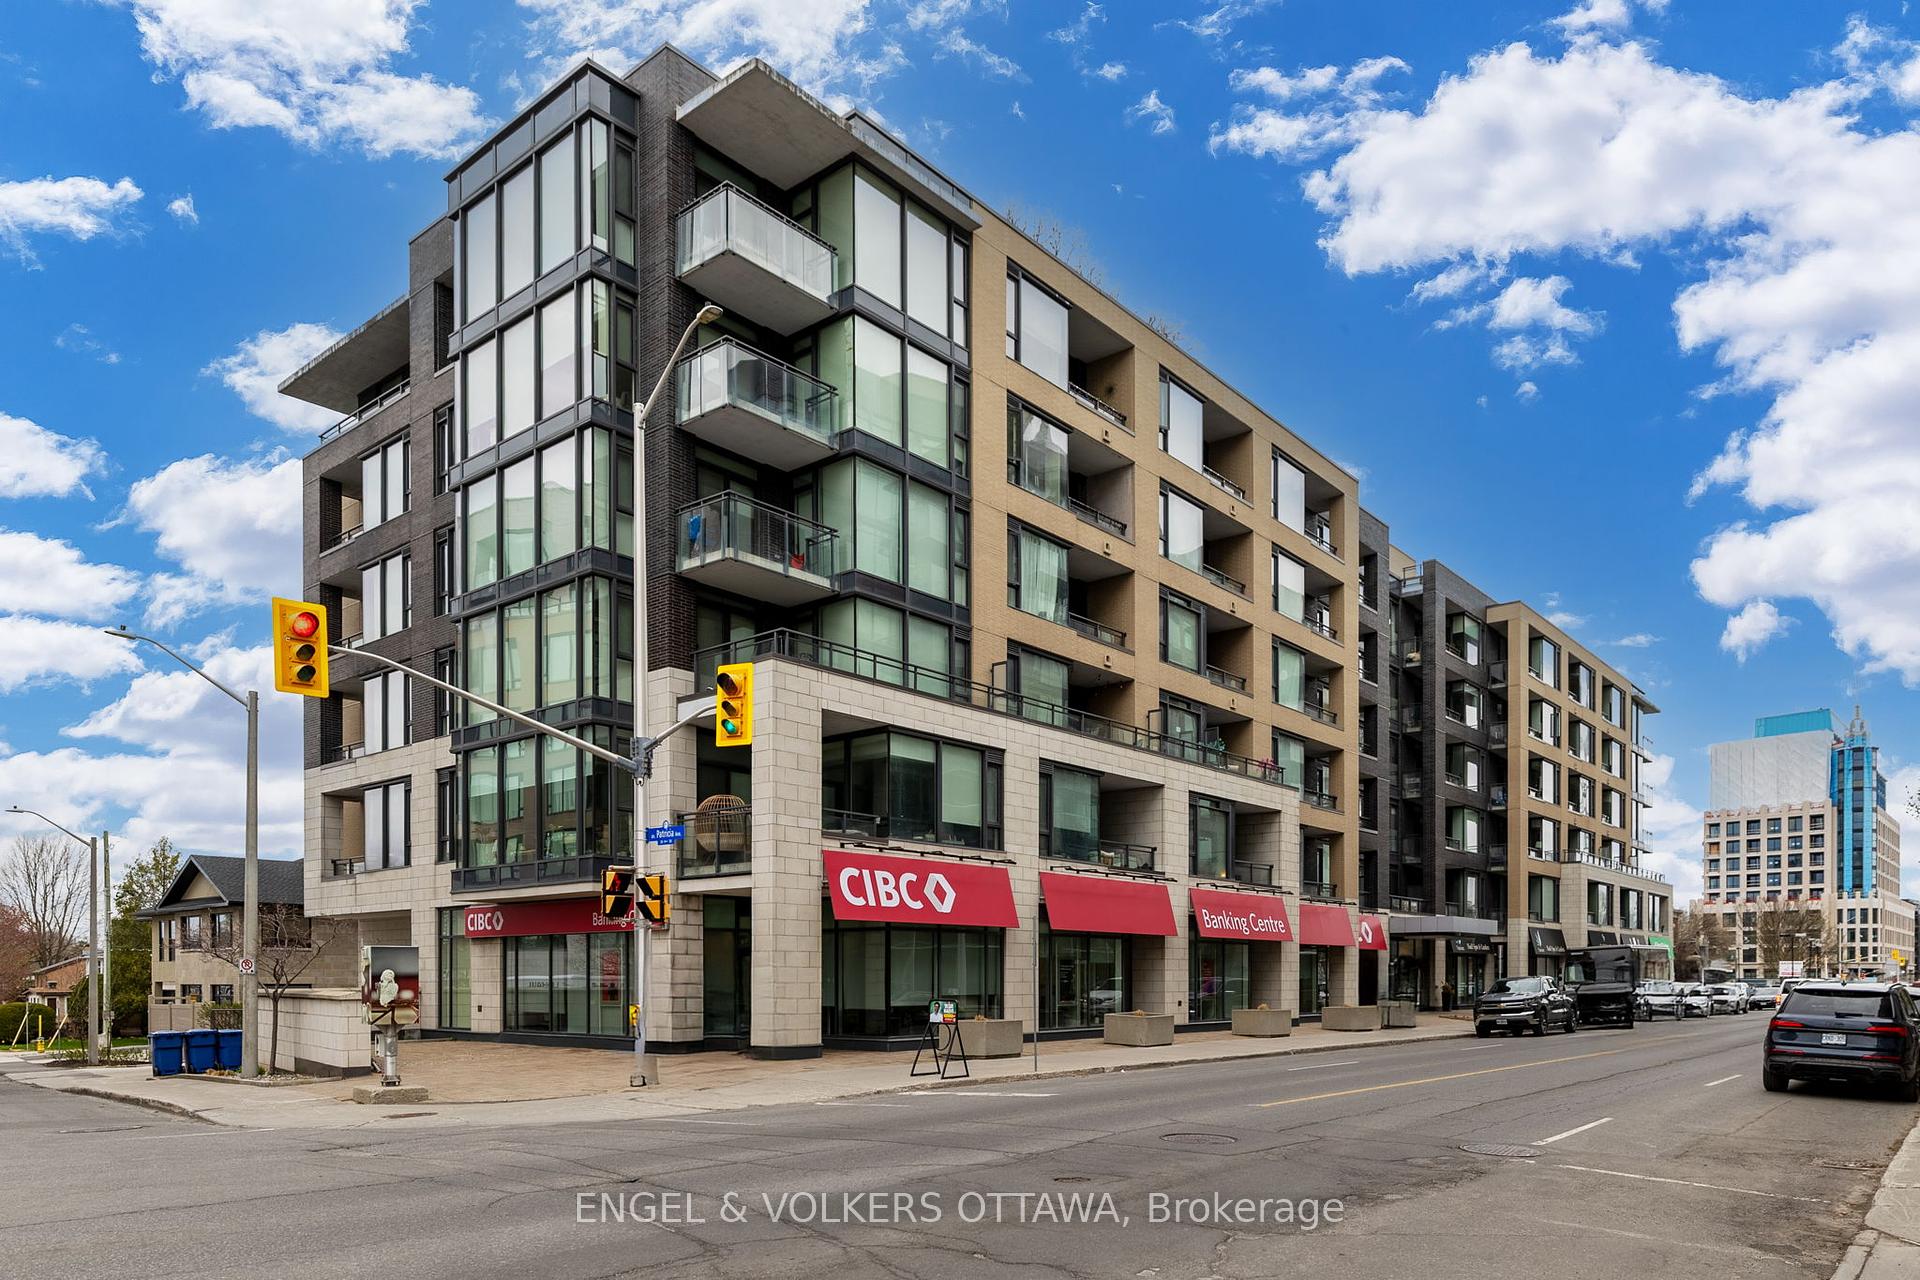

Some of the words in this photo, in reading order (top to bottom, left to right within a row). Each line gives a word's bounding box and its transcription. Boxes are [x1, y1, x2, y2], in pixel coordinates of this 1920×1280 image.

[839, 867, 924, 909] CIBC
[467, 912, 492, 931] CIBC
[1201, 908, 1250, 935] Banking
[1249, 913, 1286, 933] Centre
